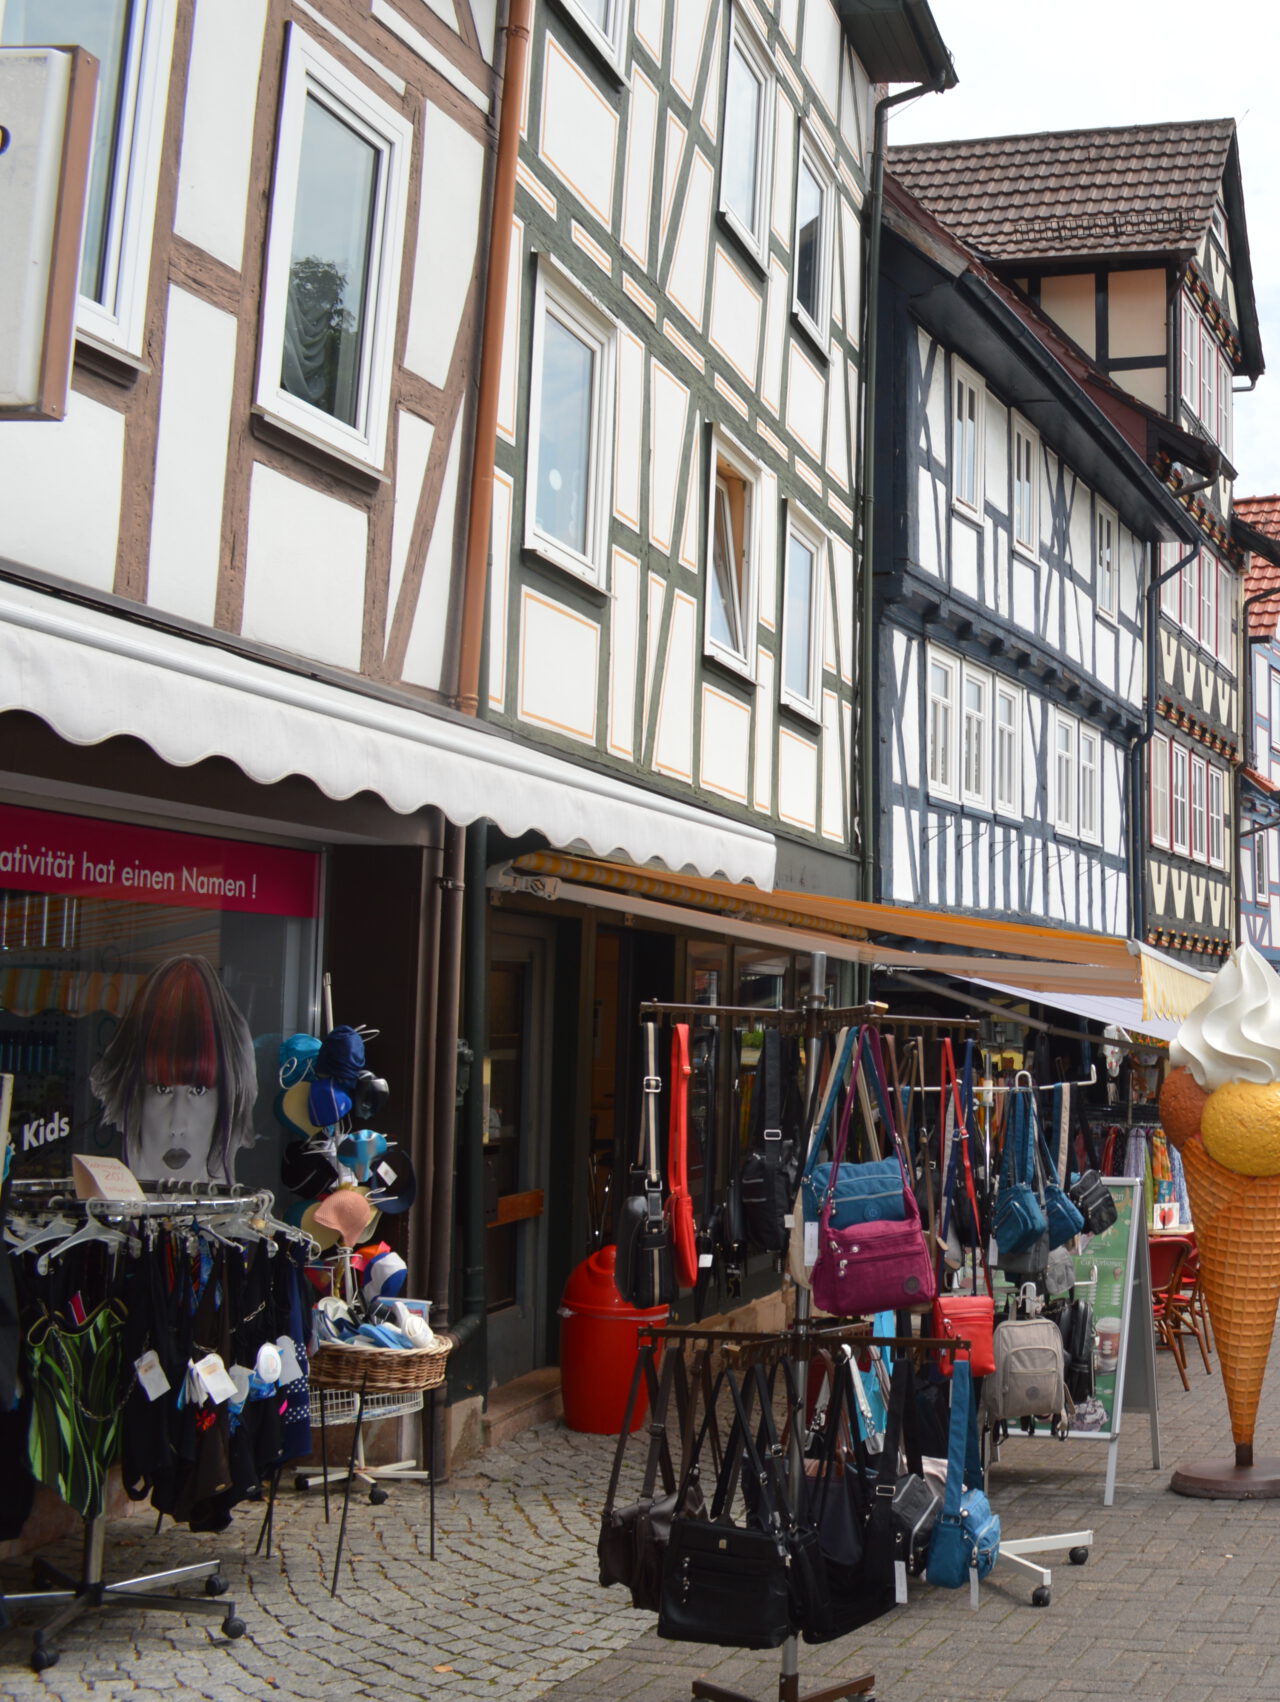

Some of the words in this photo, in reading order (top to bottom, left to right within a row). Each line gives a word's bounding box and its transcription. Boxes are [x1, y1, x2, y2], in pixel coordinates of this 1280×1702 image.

[81, 851, 116, 884] hat
[121, 860, 175, 891] einen
[181, 866, 246, 898] Namen
[23, 1111, 70, 1151] Kids
